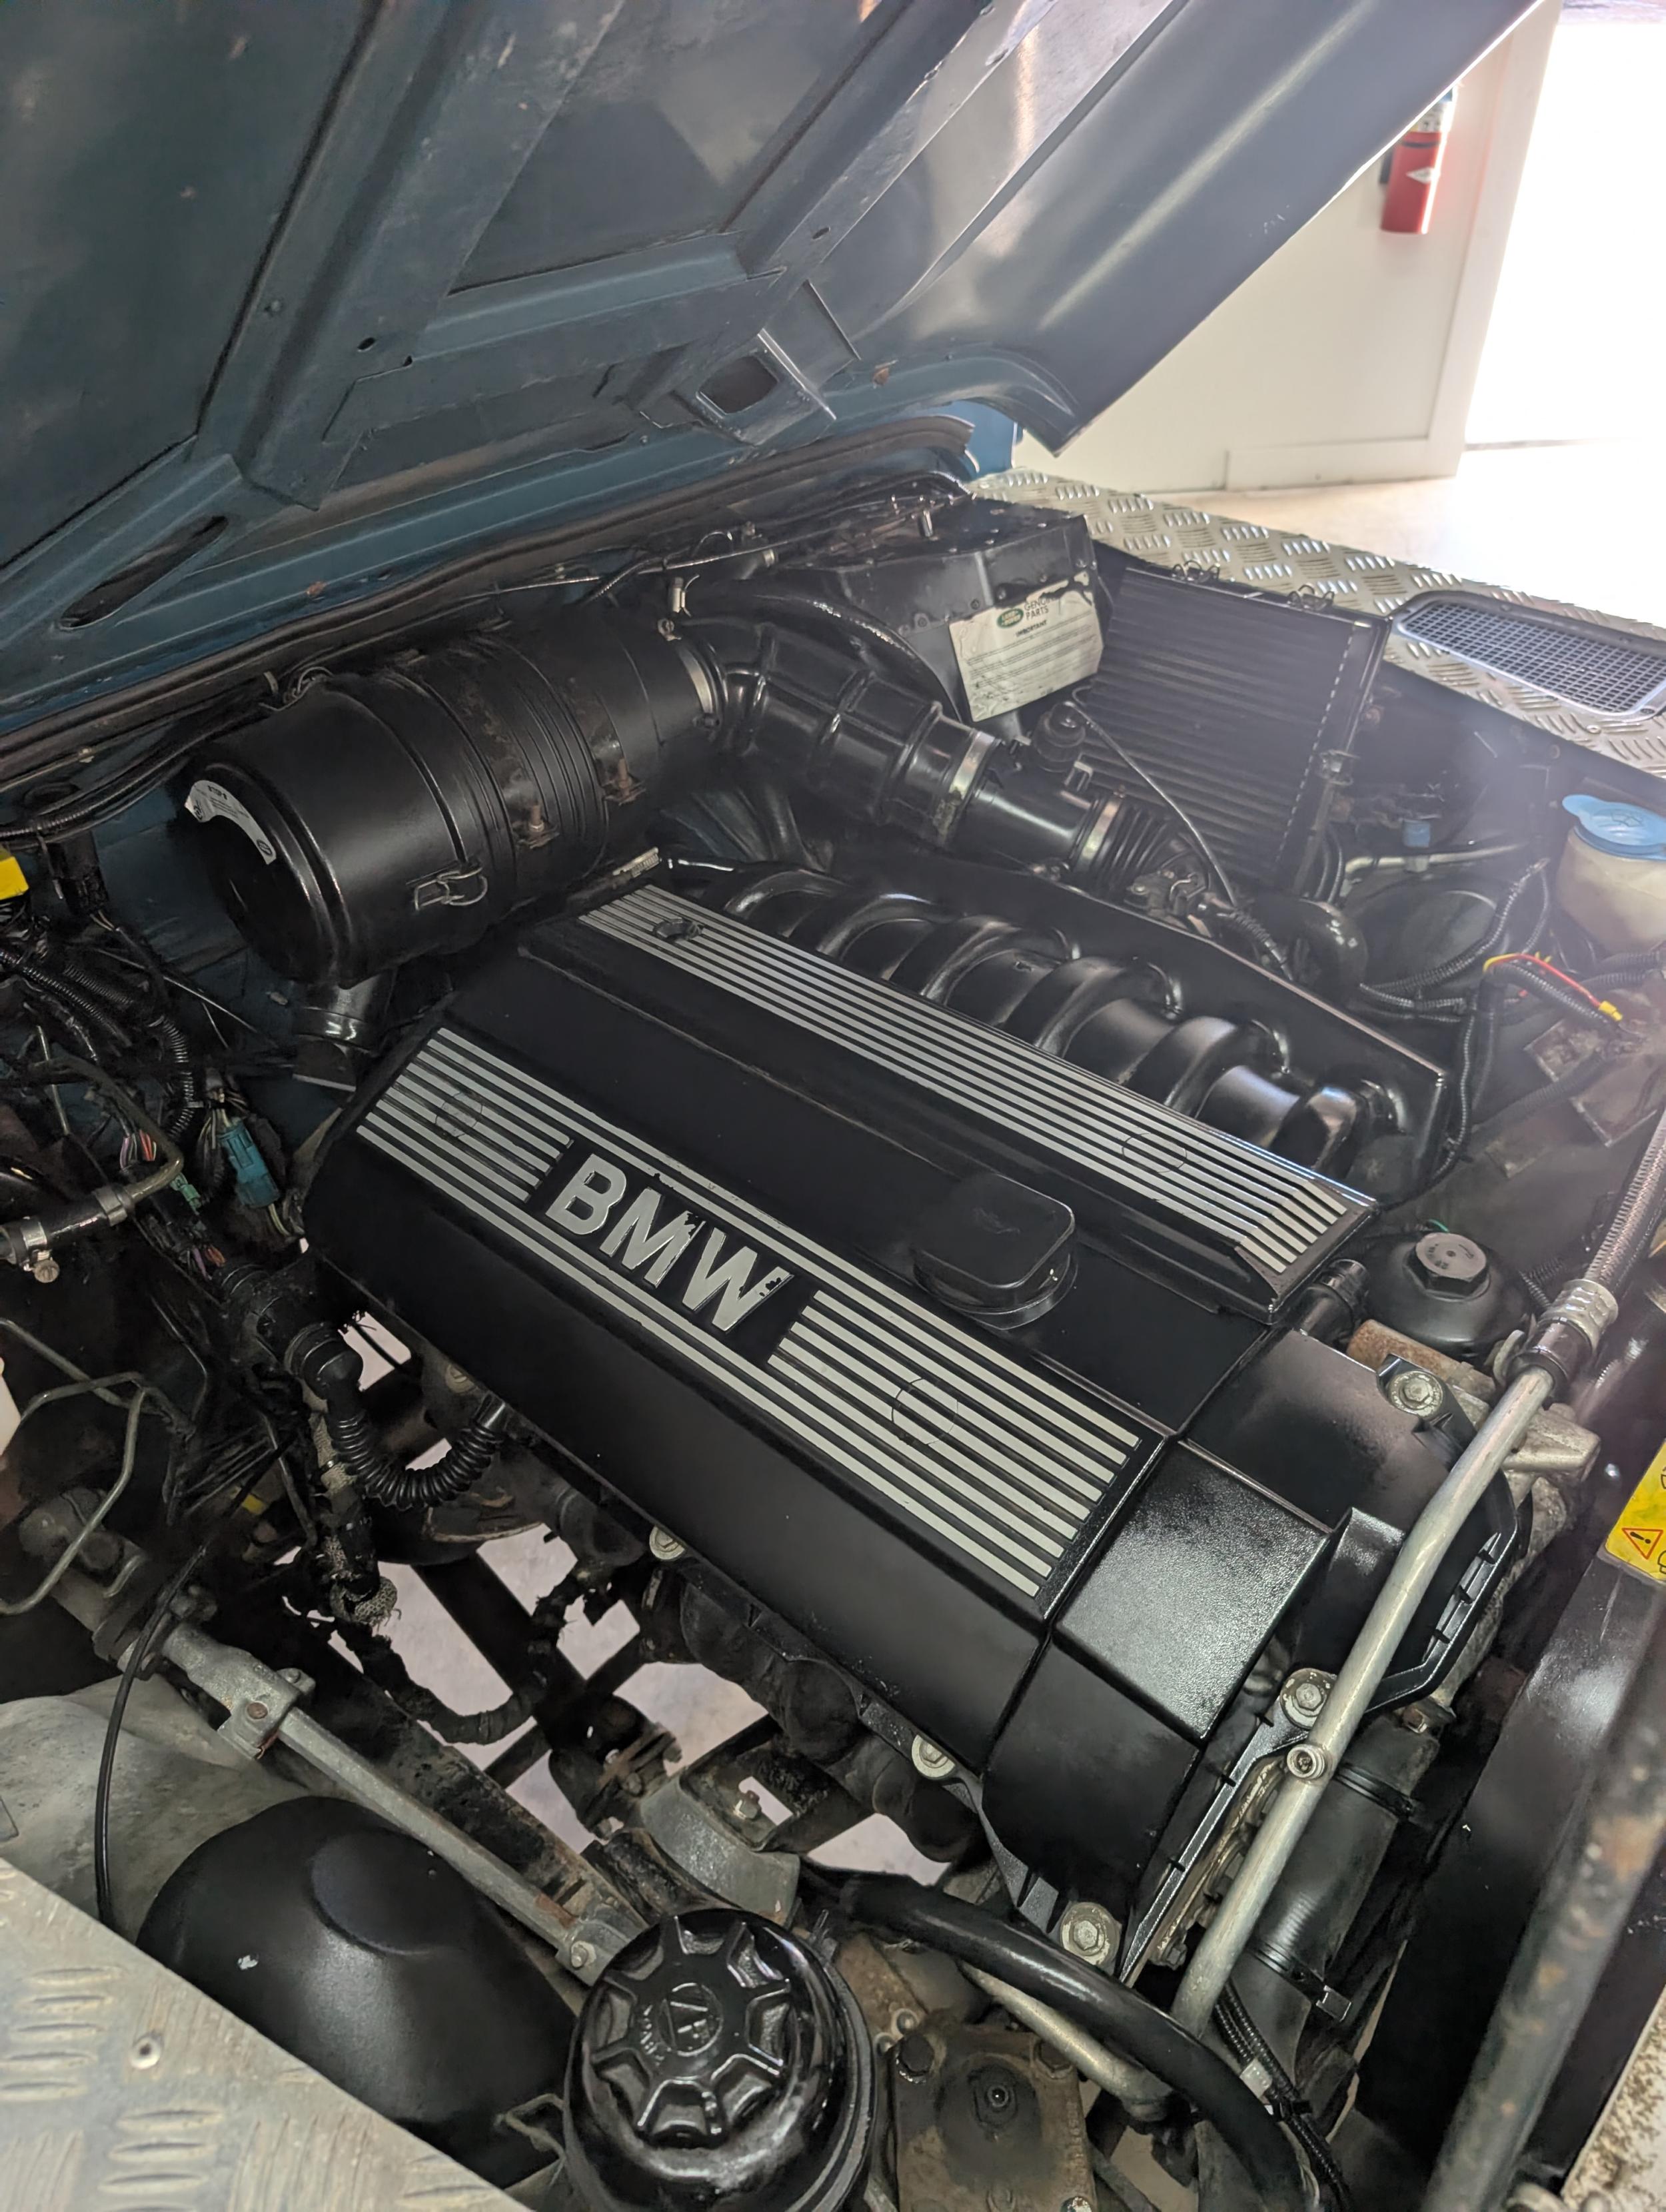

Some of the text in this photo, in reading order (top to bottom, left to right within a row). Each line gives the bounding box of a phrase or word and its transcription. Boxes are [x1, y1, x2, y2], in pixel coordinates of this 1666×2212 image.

[1026, 606, 1049, 620] PARTS
[1016, 620, 1047, 636] IMPORTANT
[545, 1153, 794, 1332] BMW
